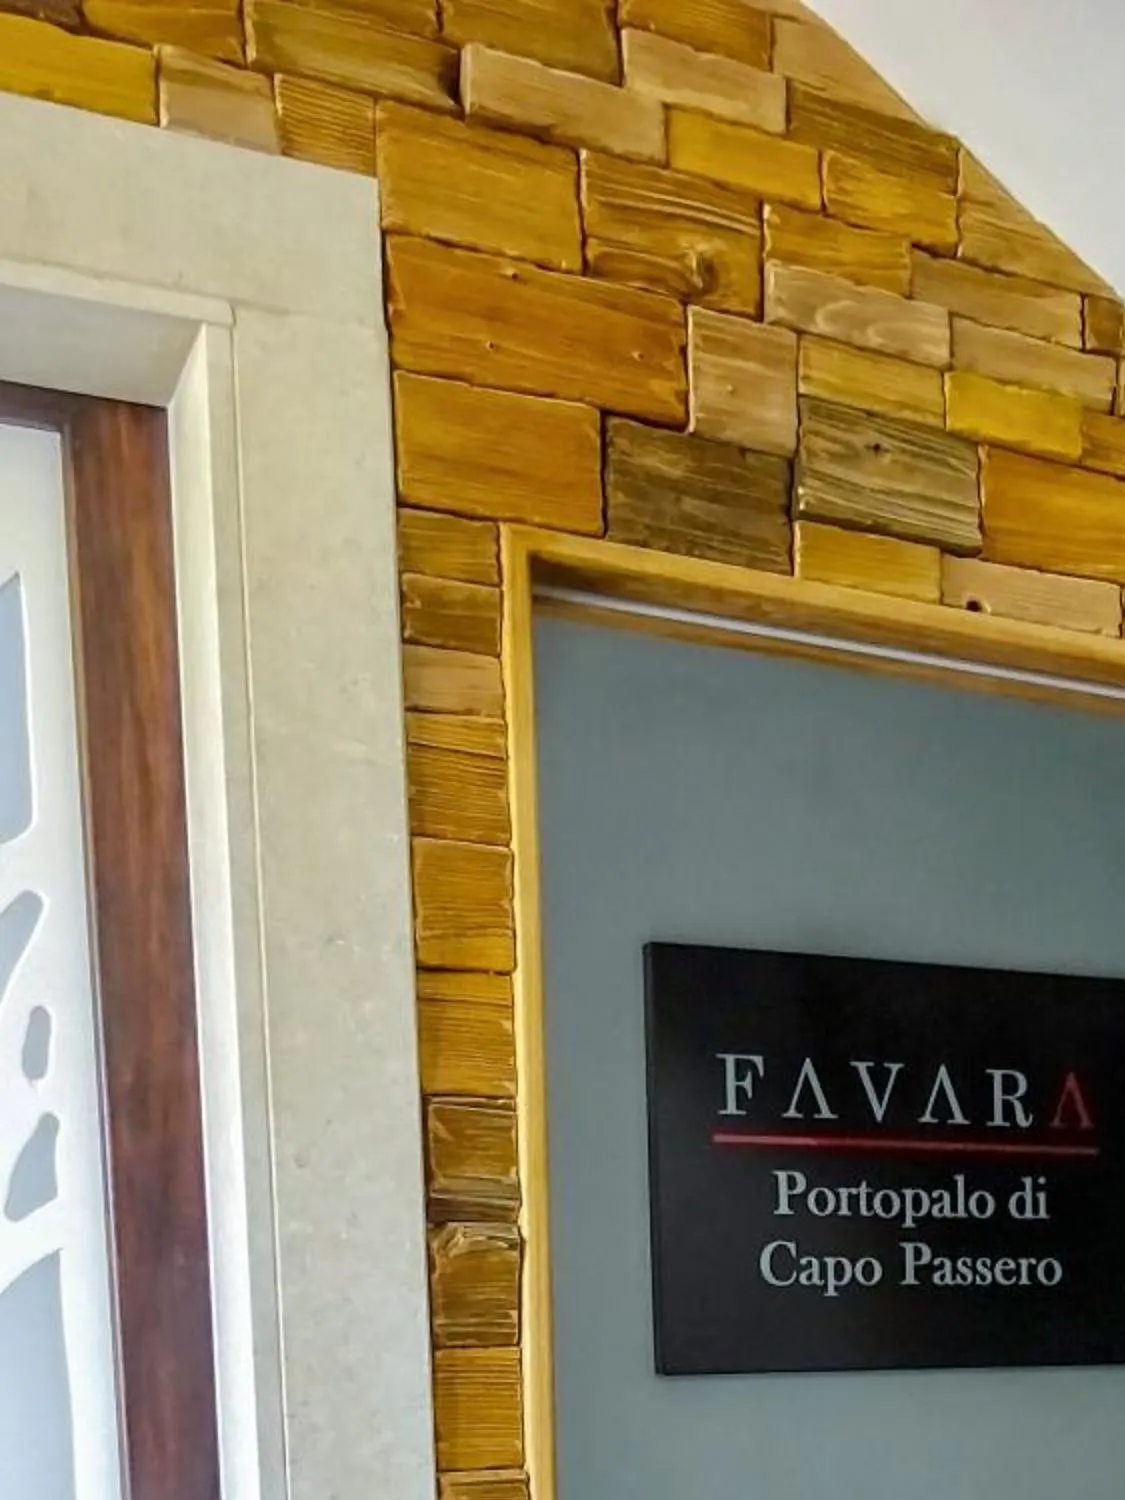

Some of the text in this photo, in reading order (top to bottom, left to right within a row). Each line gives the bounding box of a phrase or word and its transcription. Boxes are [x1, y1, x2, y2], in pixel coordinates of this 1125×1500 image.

[715, 1052, 1096, 1130] FAVARA
[771, 1169, 1051, 1228] Portopalo di
[758, 1240, 1064, 1296] Capo Passero
